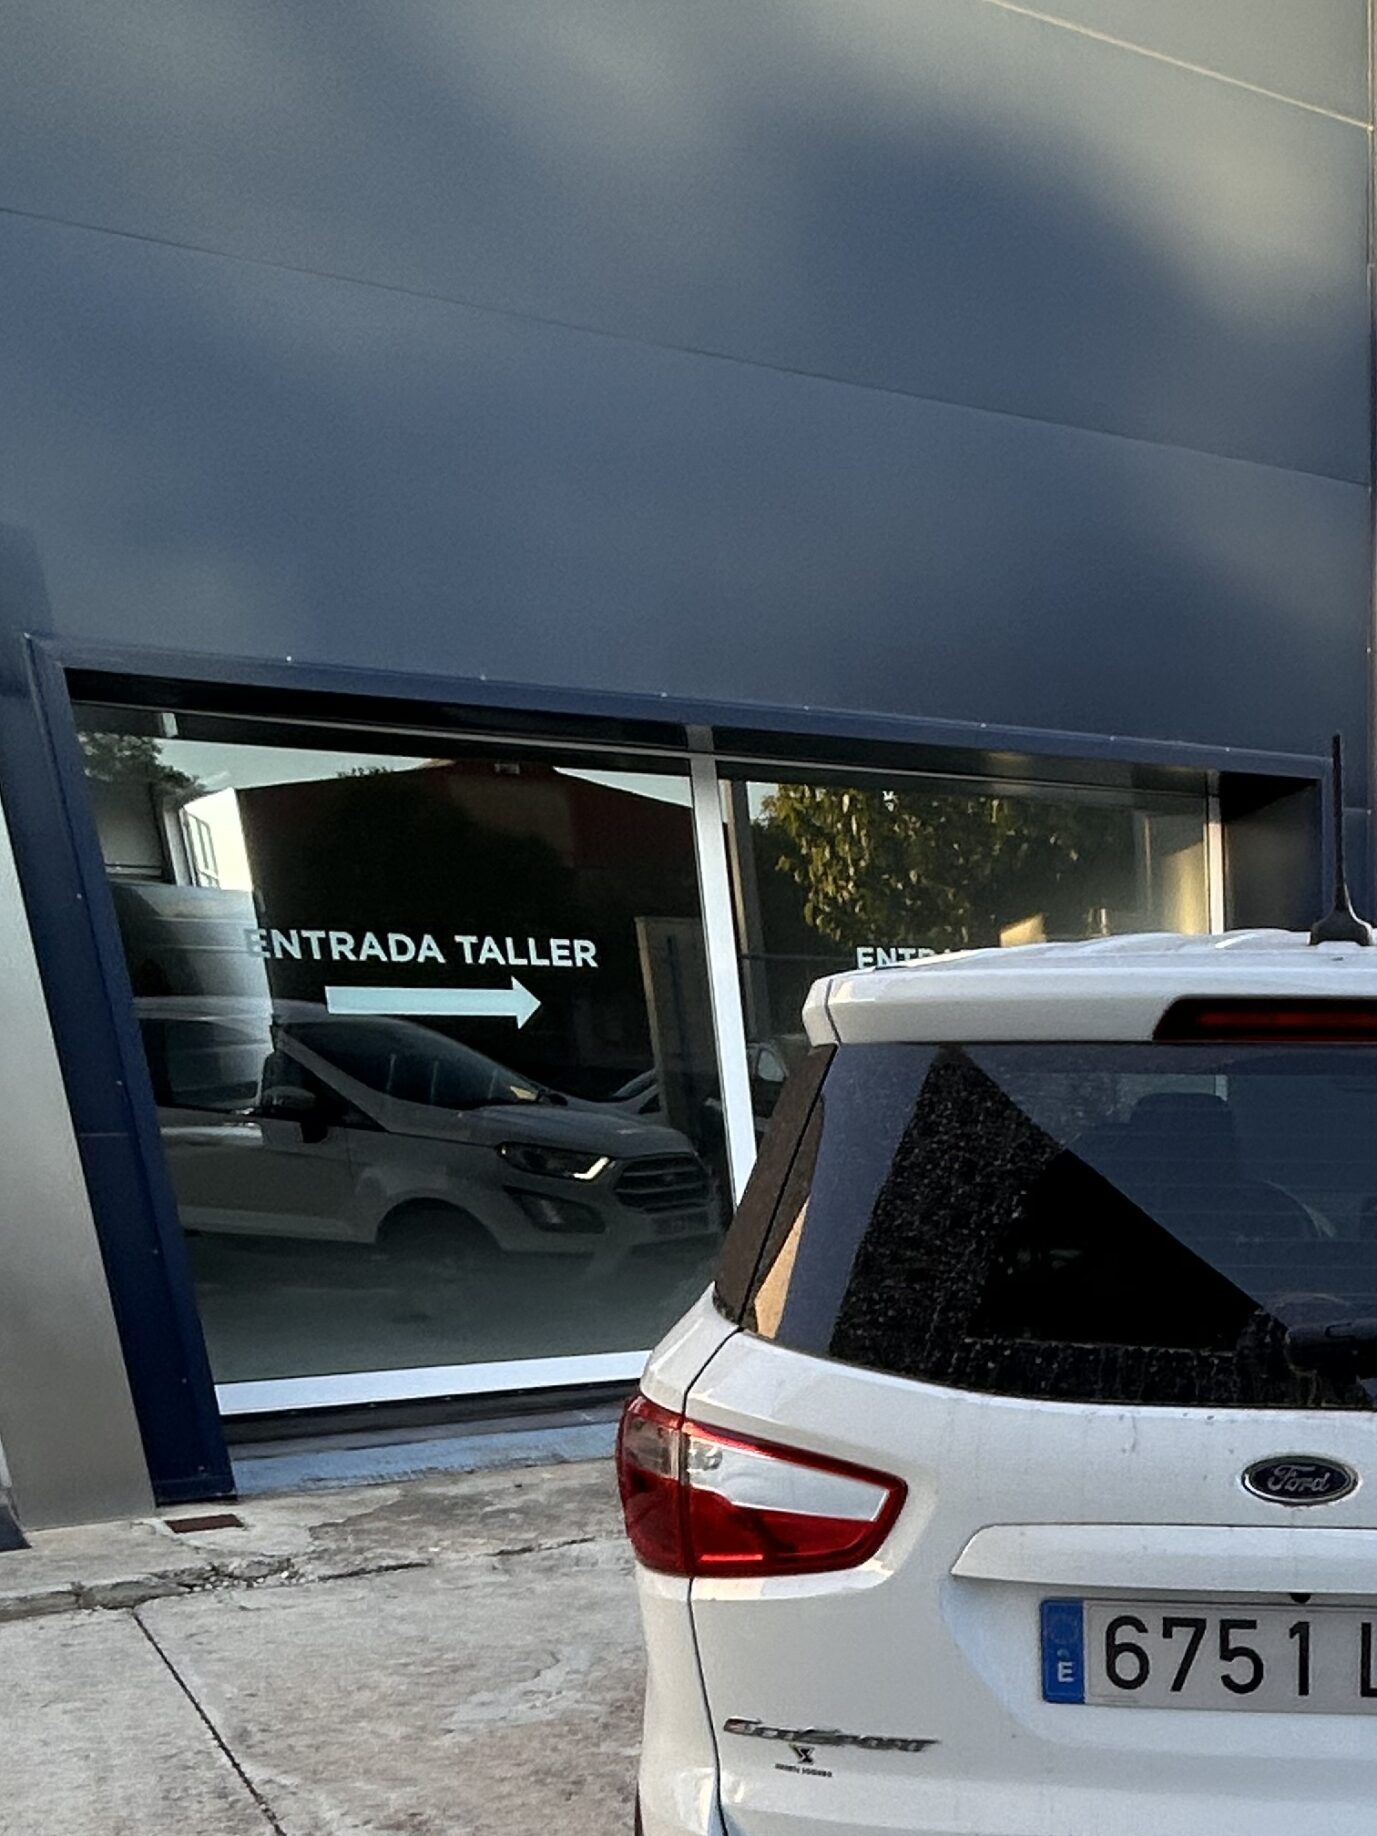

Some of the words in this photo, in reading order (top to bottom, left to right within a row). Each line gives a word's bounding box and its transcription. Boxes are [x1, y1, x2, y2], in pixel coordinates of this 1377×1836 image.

[243, 928, 446, 964] ENTRADA
[455, 935, 599, 969] TALLER
[1267, 1465, 1330, 1491] Ford
[1058, 1661, 1074, 1682] E
[1104, 1615, 1311, 1697] 6751
